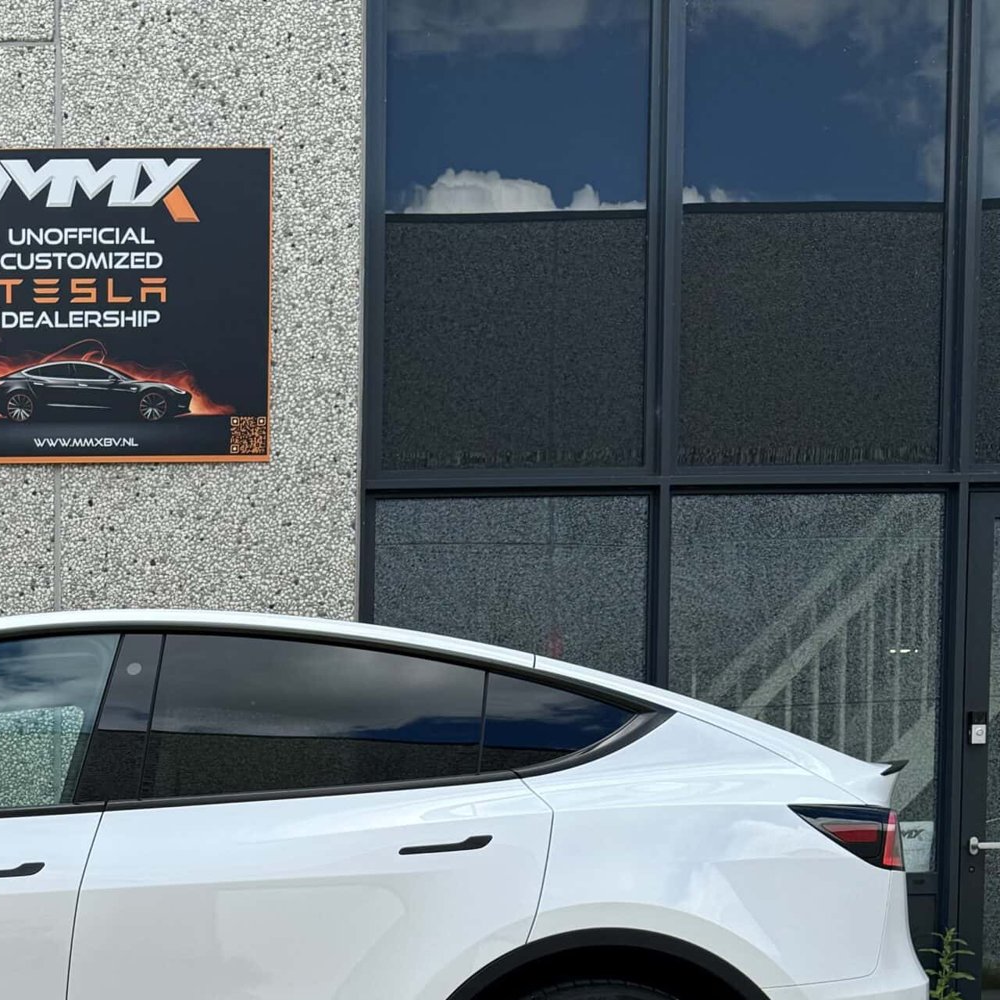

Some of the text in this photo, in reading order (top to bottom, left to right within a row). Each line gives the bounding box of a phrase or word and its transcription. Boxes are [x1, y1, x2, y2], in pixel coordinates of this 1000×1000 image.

[8, 227, 156, 246] UNOFFICIAL
[0, 252, 164, 270] CUSTOMIZED
[1, 310, 161, 328] DEALERSHIP
[34, 437, 139, 448] WWW.MMXBV.NL
